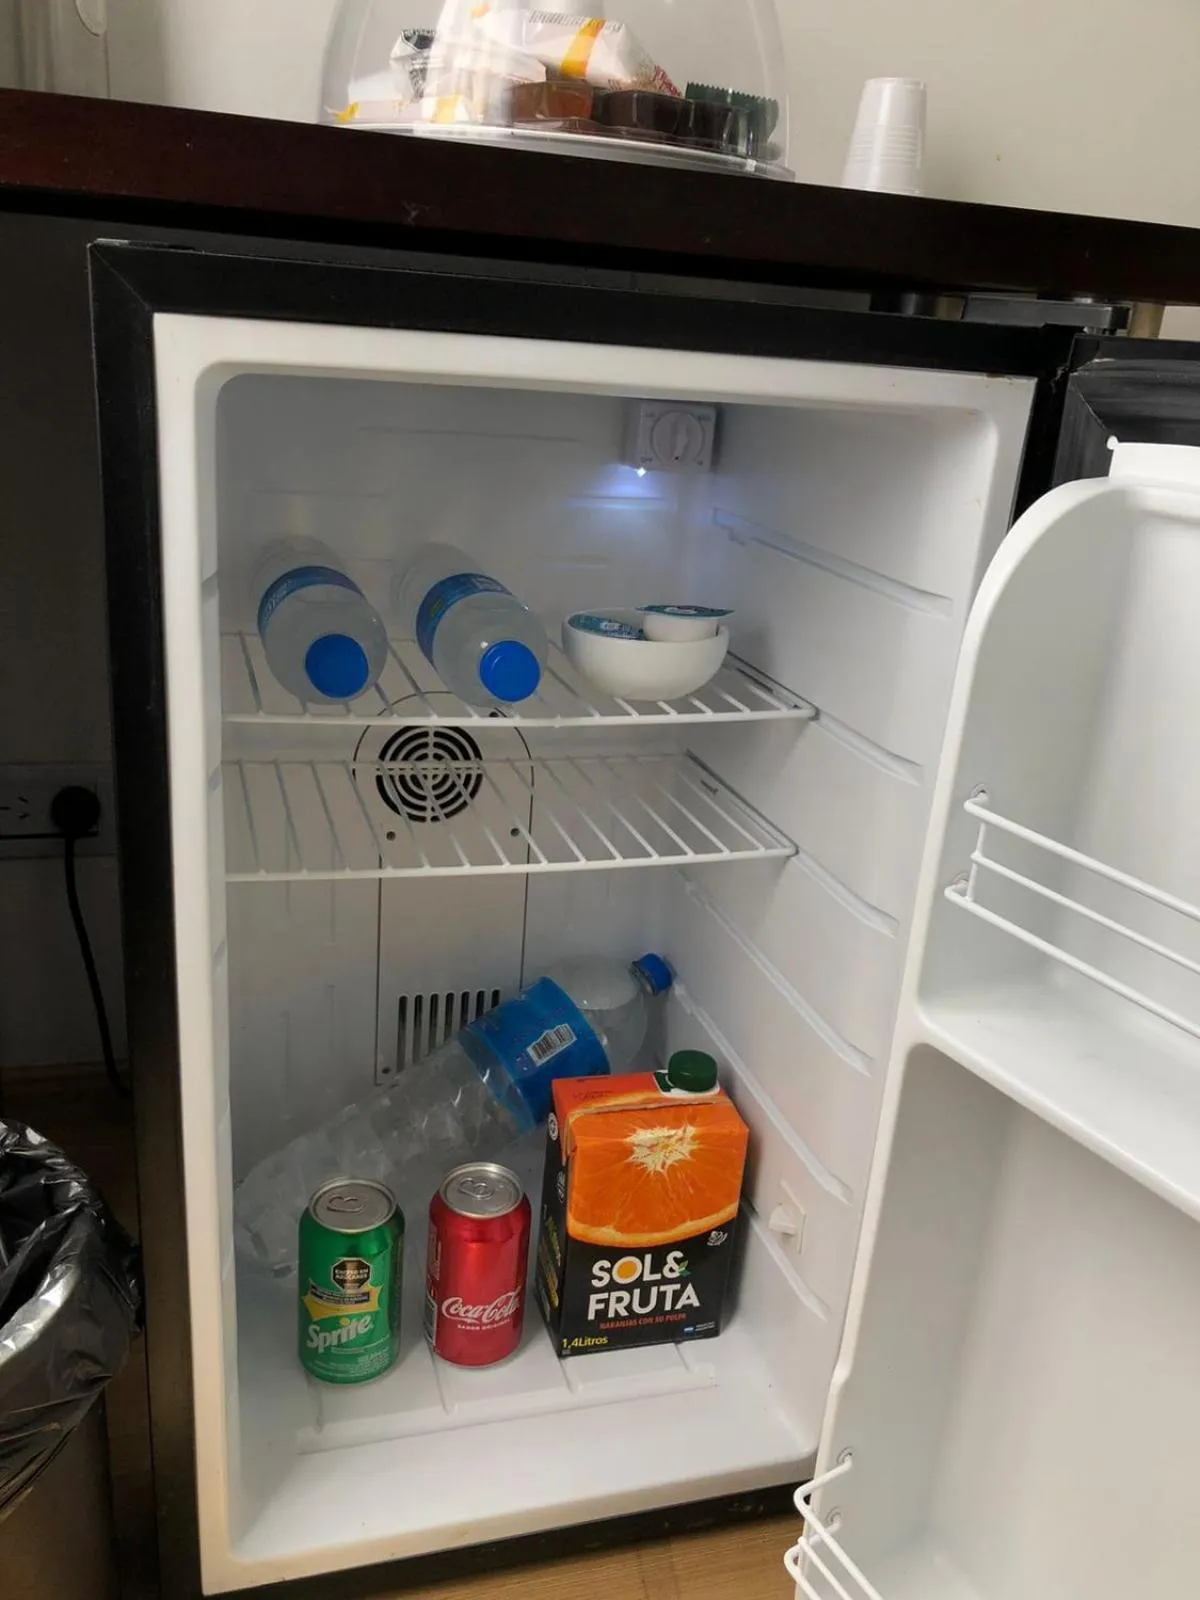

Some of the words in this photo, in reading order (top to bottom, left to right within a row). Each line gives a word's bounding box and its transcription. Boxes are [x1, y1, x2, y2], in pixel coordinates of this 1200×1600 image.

[442, 1290, 520, 1324] Coca-Cola
[587, 1282, 701, 1321] FRUTA
[306, 1315, 374, 1354] Sprite
